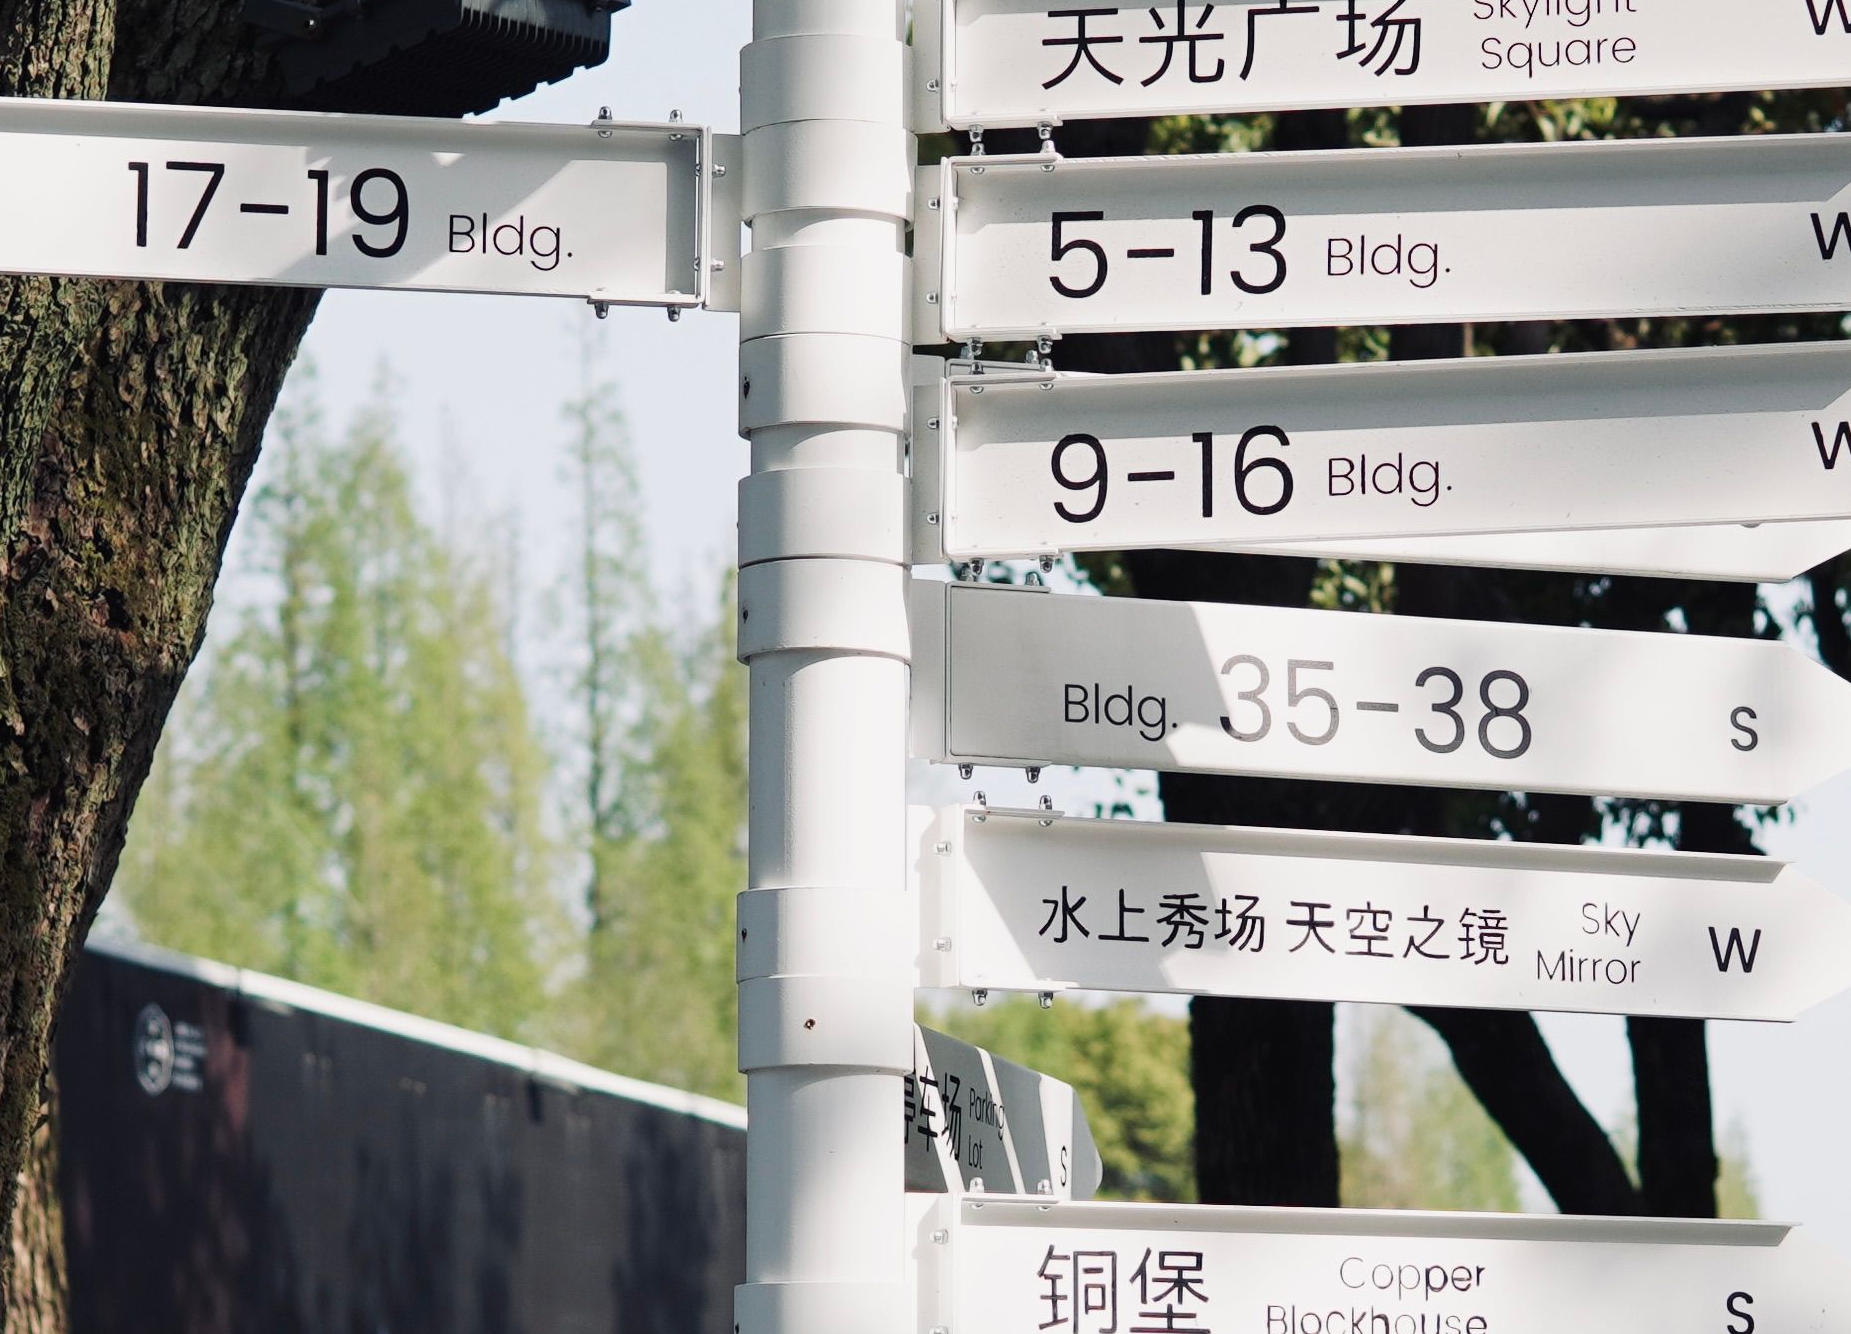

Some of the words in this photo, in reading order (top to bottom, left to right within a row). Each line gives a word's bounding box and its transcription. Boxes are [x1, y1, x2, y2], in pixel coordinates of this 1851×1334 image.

[1481, 32, 1637, 78] Square
[127, 160, 410, 259] 17-19
[448, 212, 573, 272] Bldg.
[1048, 204, 1290, 299] 5-13
[1327, 233, 1452, 289] Bldg.
[1051, 424, 1297, 524] 9-16
[1328, 451, 1454, 508] Bldg.
[1063, 682, 1180, 742] Bldg.
[1219, 654, 1533, 760] 35-38
[1729, 705, 1759, 752] S
[1038, 885, 1266, 953] 水上秀场
[1285, 900, 1510, 966] 天空之镜
[1582, 902, 1641, 948] Sky
[1537, 945, 1642, 985] Mirror
[1707, 925, 1762, 975] W
[969, 1087, 1005, 1141] Parking
[968, 1134, 983, 1170] Lot
[1060, 1145, 1068, 1187] S
[1339, 1256, 1486, 1301] Copper
